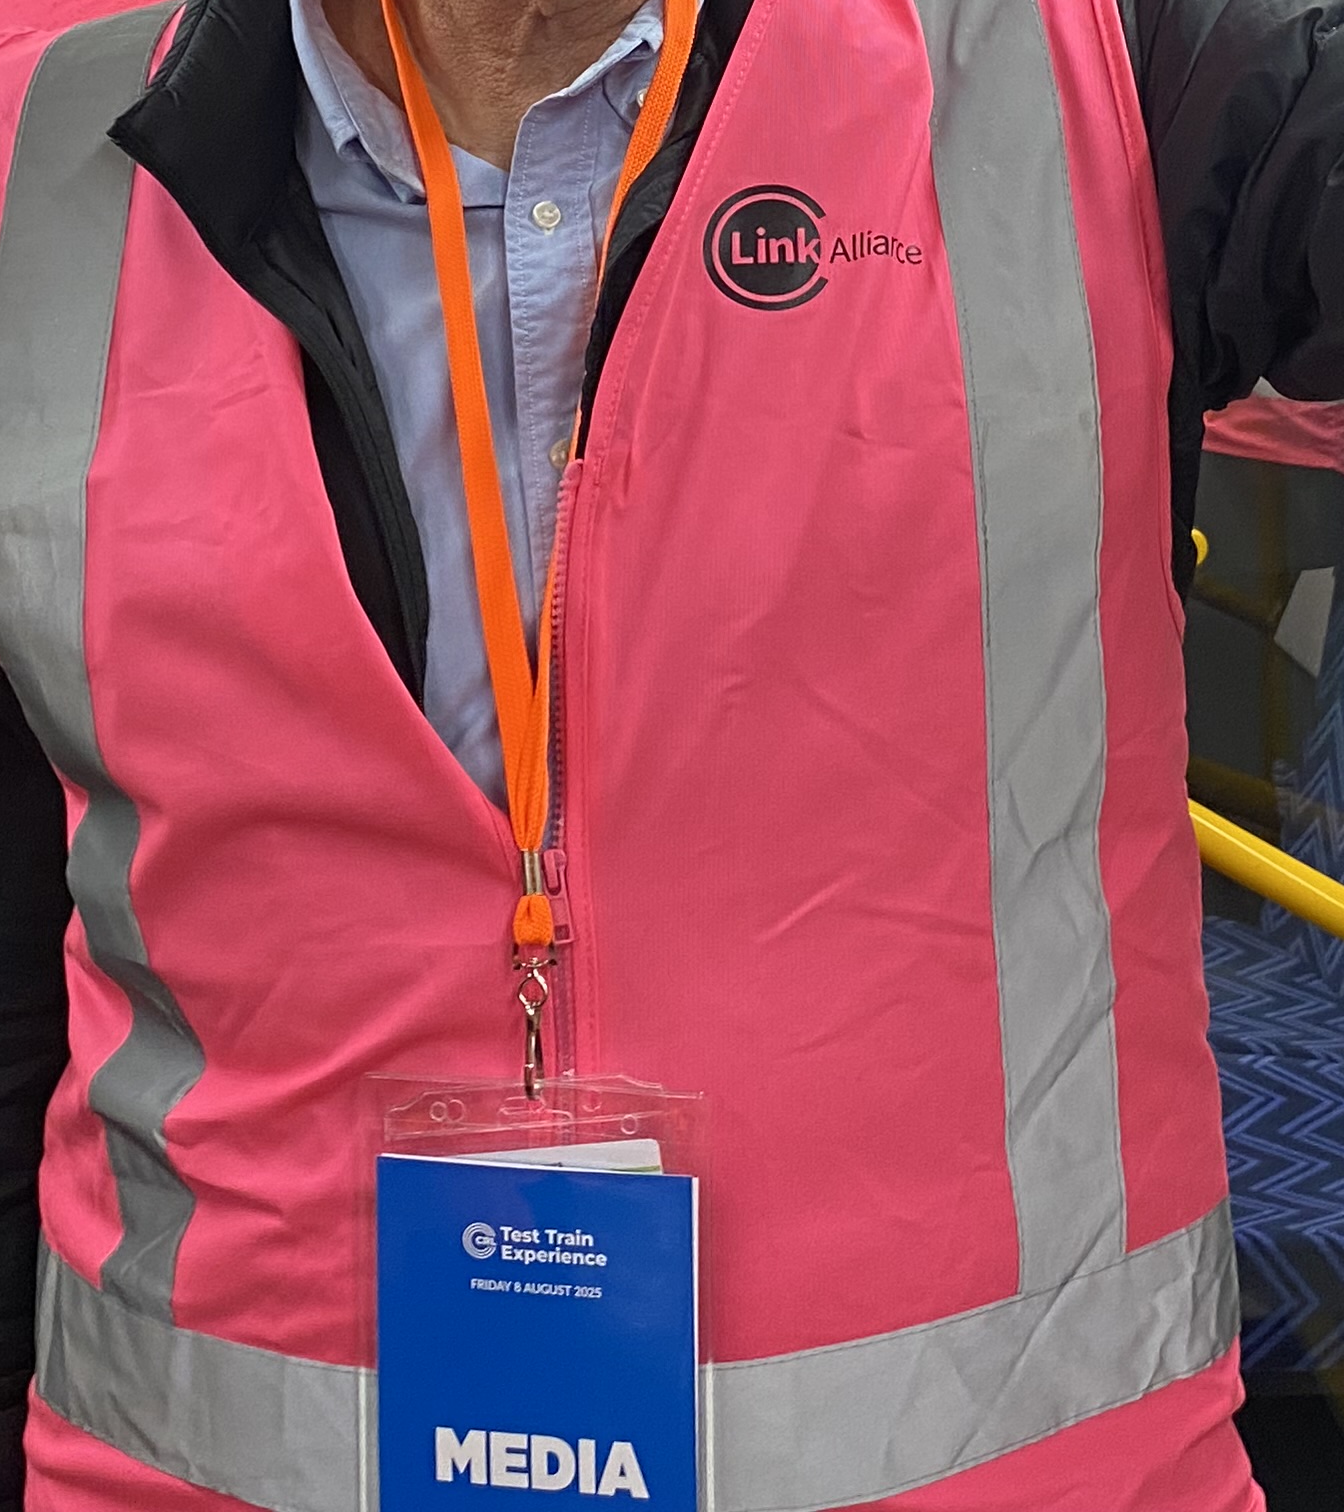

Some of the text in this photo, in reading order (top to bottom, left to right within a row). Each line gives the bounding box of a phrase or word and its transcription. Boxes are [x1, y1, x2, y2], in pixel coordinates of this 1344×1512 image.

[731, 227, 821, 265] Link
[500, 1226, 594, 1247] Test Train
[500, 1245, 608, 1266] Experience
[470, 1278, 512, 1292] FRIDAY
[523, 1282, 572, 1297] AUGUST
[574, 1285, 602, 1299] 2025
[435, 1426, 650, 1499] MEDIA
